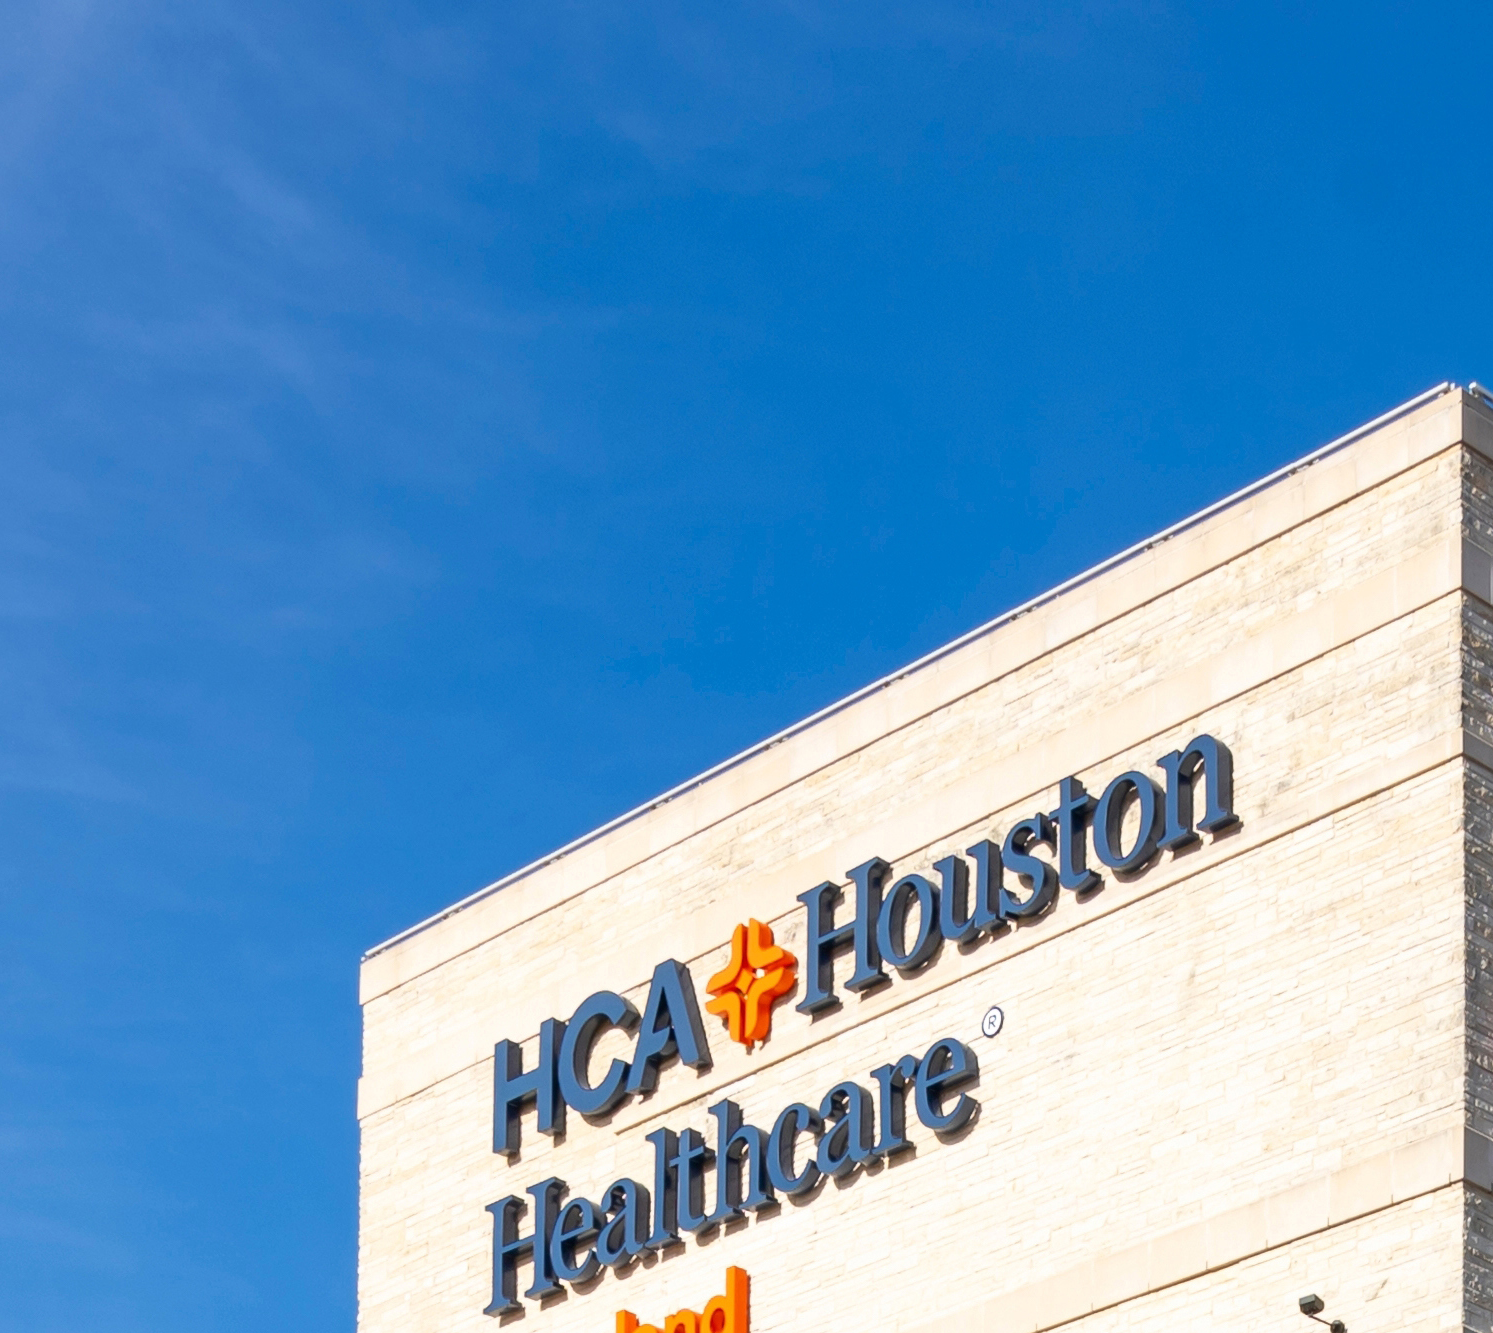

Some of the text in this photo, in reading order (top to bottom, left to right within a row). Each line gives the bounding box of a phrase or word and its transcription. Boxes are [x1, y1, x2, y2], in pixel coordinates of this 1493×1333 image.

[492, 733, 1240, 1157] HCA Houston
[483, 1037, 980, 1317] Healthcare
